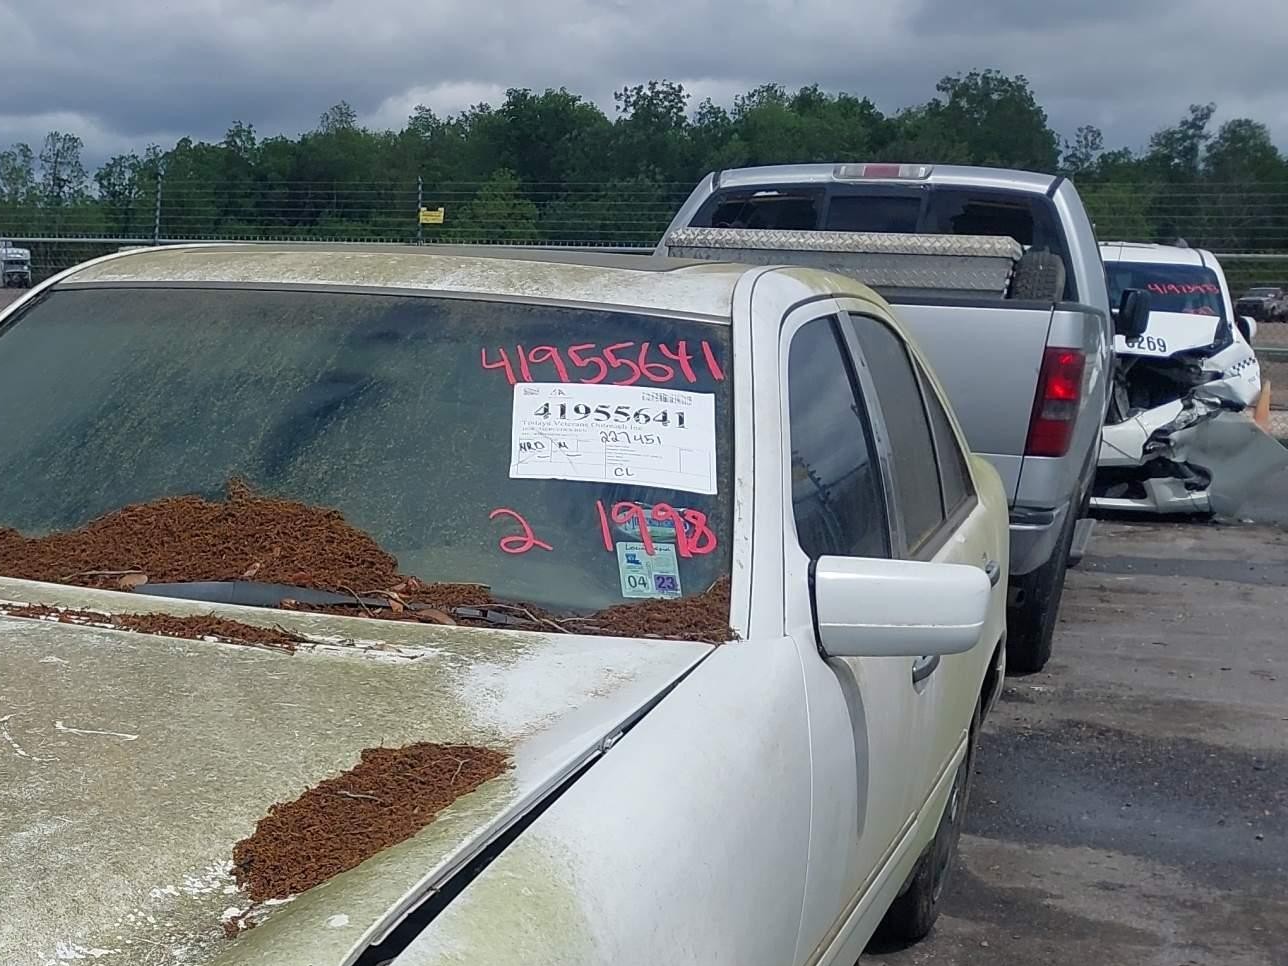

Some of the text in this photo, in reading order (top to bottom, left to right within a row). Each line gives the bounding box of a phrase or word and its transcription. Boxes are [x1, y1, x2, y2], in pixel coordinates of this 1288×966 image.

[481, 341, 726, 386] 41955641
[534, 402, 688, 429] 41955641
[489, 508, 553, 553] 2
[596, 500, 717, 558] 1998
[627, 575, 647, 588] 04
[657, 576, 675, 589] 23
